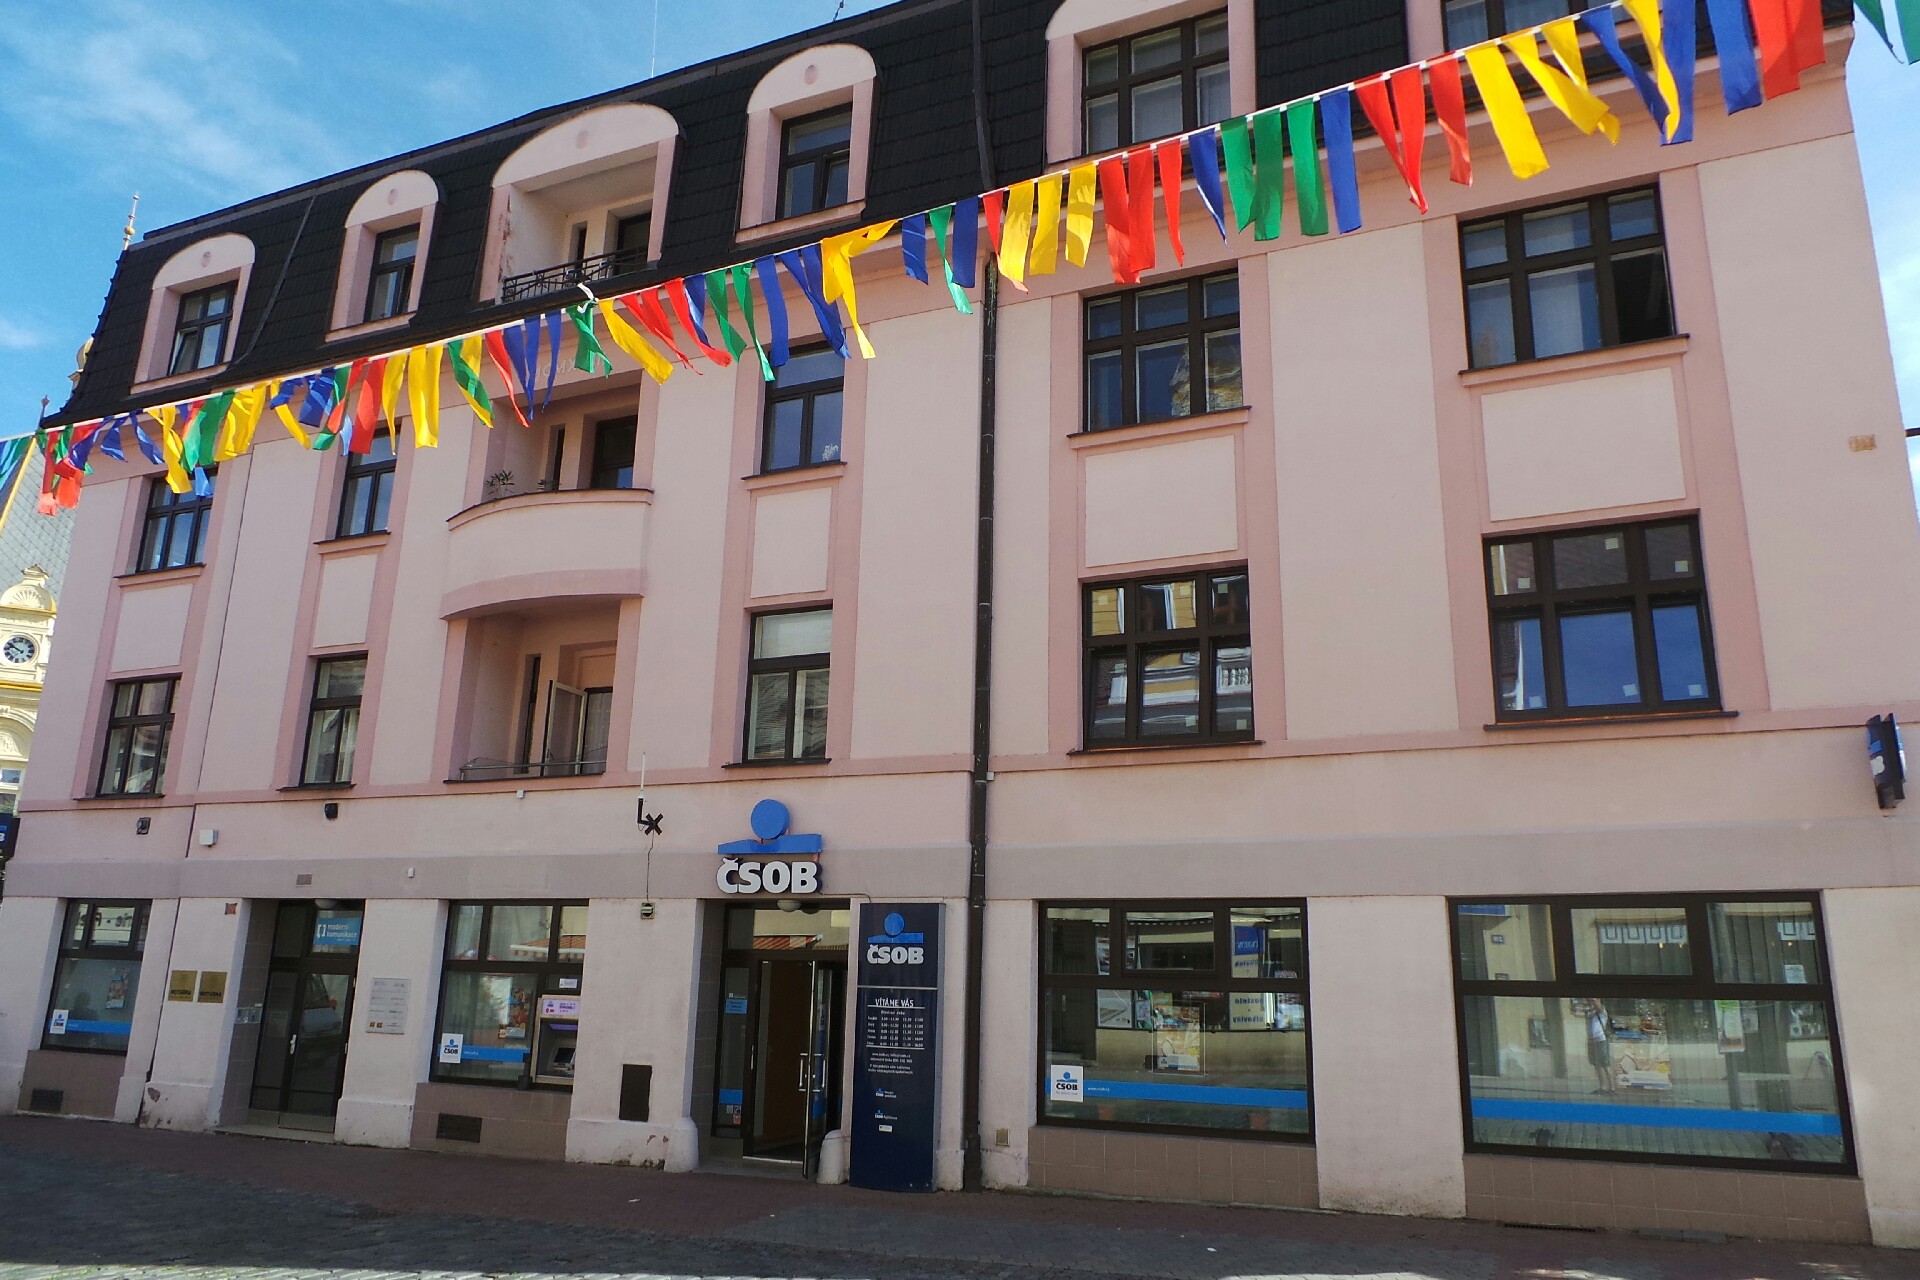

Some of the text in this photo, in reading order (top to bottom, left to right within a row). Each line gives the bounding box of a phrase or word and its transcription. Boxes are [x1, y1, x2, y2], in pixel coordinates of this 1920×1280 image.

[716, 857, 818, 894] ČSOB
[867, 944, 924, 965] ČSOB
[900, 998, 914, 1009] VÁS
[1056, 1082, 1078, 1091] ČSOB
